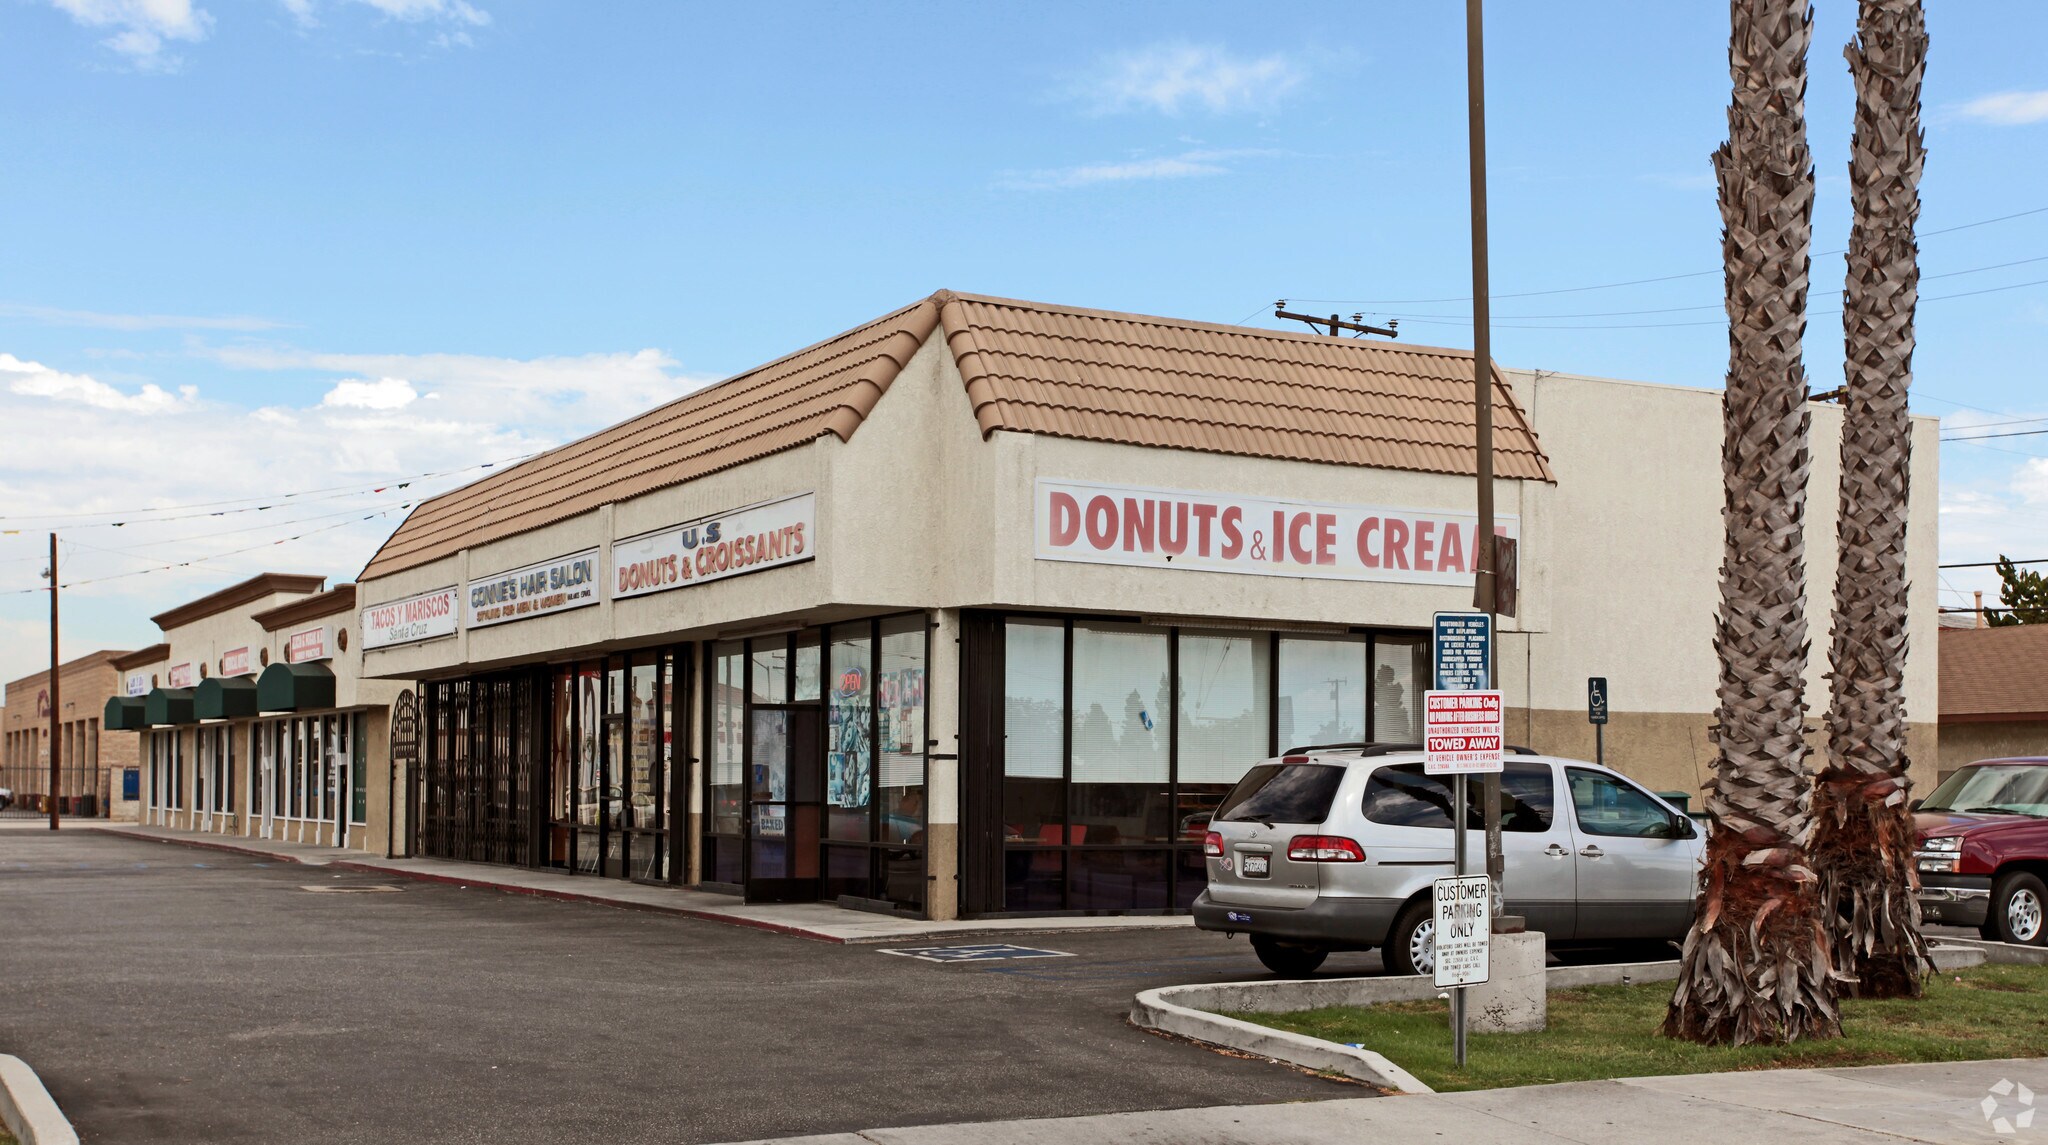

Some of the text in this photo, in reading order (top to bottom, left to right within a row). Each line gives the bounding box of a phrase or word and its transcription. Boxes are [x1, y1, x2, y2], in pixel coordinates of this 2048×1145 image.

[1049, 491, 1243, 560] DONUTS
[1250, 530, 1267, 561] &
[1272, 511, 1336, 566] ICE
[619, 522, 805, 592] DONUTS & CROISSANTS
[472, 560, 592, 608] CONNIE'S HAIR SALON
[372, 594, 450, 630] TACOS Y MARISCOS
[502, 604, 515, 617] FOR
[516, 599, 531, 614] MEN
[540, 592, 566, 610] WOMEN
[390, 622, 428, 640] Santa Cruz
[840, 674, 861, 690] OPEN
[1430, 697, 1498, 710] CUSTOMER PARKING Only
[1430, 737, 1498, 750] TOWED AWAY
[761, 819, 783, 830] BAKED
[1438, 884, 1487, 901] CUSTOMER
[1443, 903, 1482, 920] PARKING
[1450, 922, 1474, 938] ONLY
